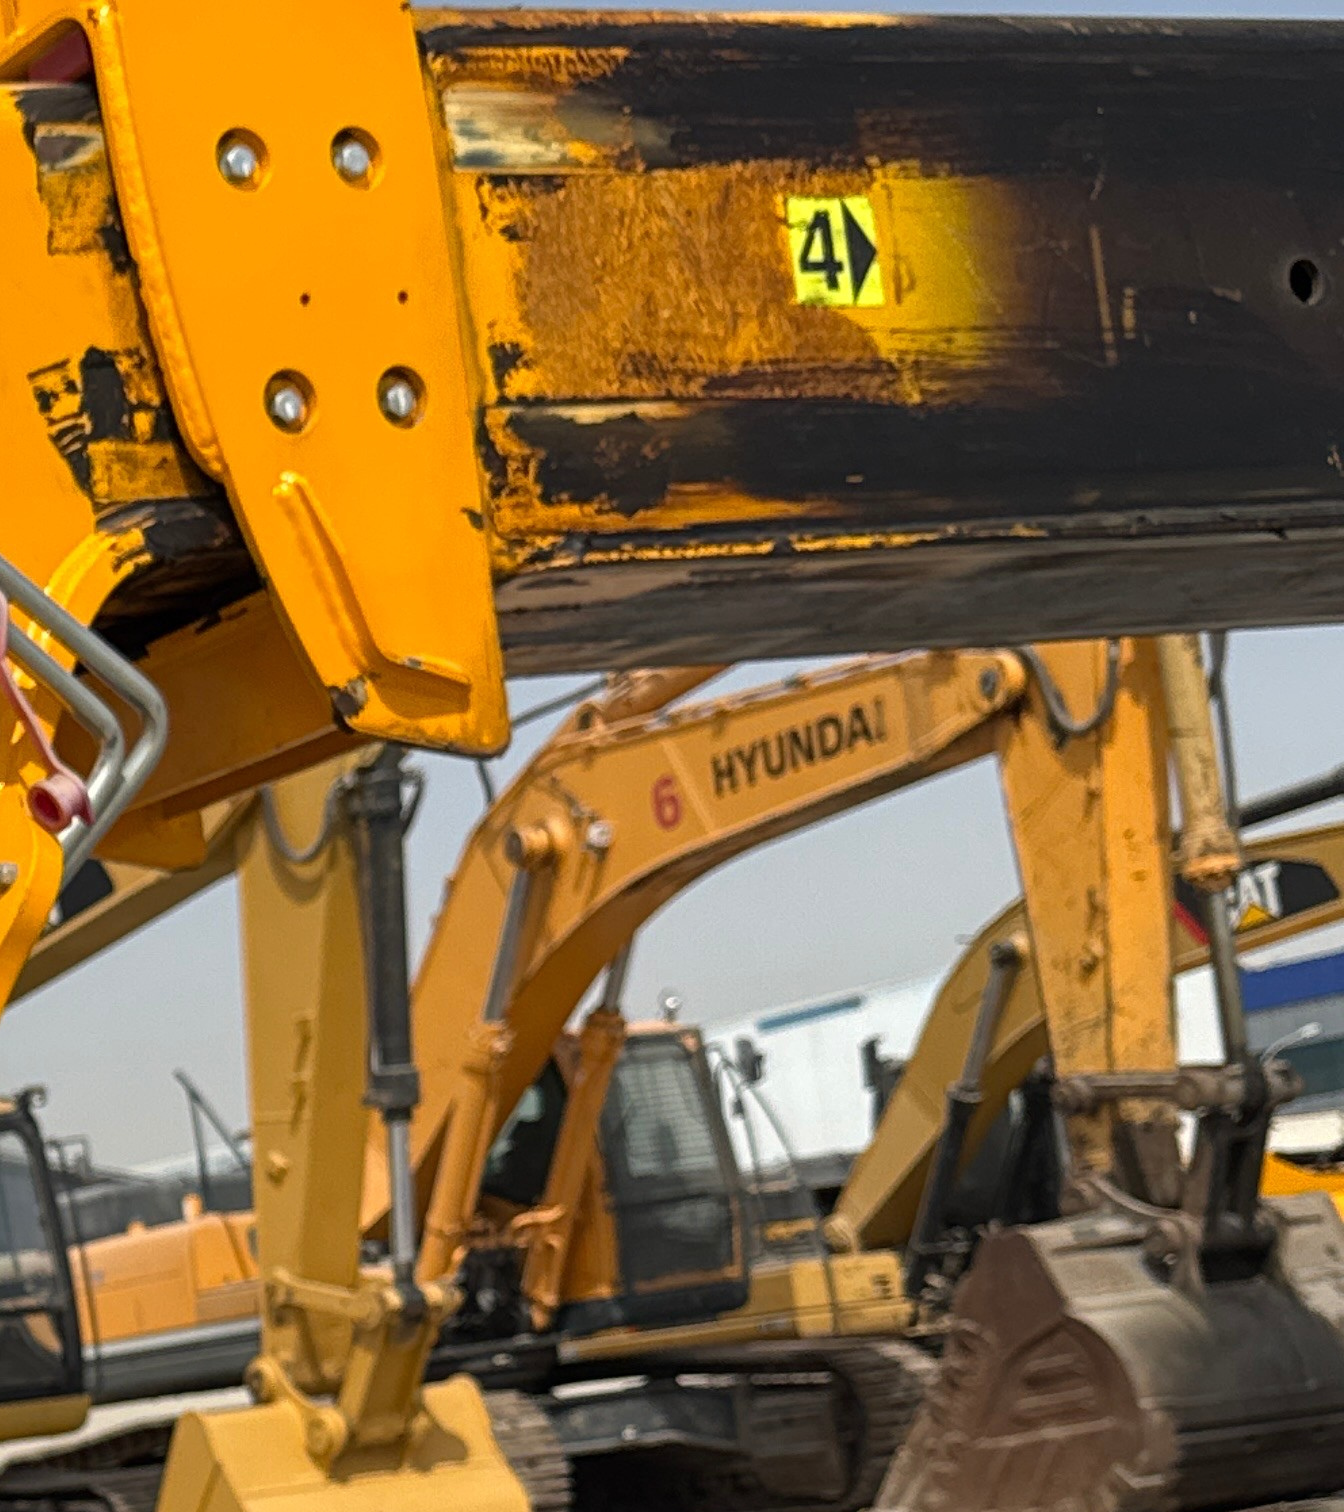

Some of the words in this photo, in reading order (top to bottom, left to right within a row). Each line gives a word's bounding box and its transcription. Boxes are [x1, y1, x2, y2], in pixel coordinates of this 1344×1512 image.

[799, 209, 843, 291] 4
[709, 695, 888, 799] HYUNDAI
[652, 774, 682, 832] 6
